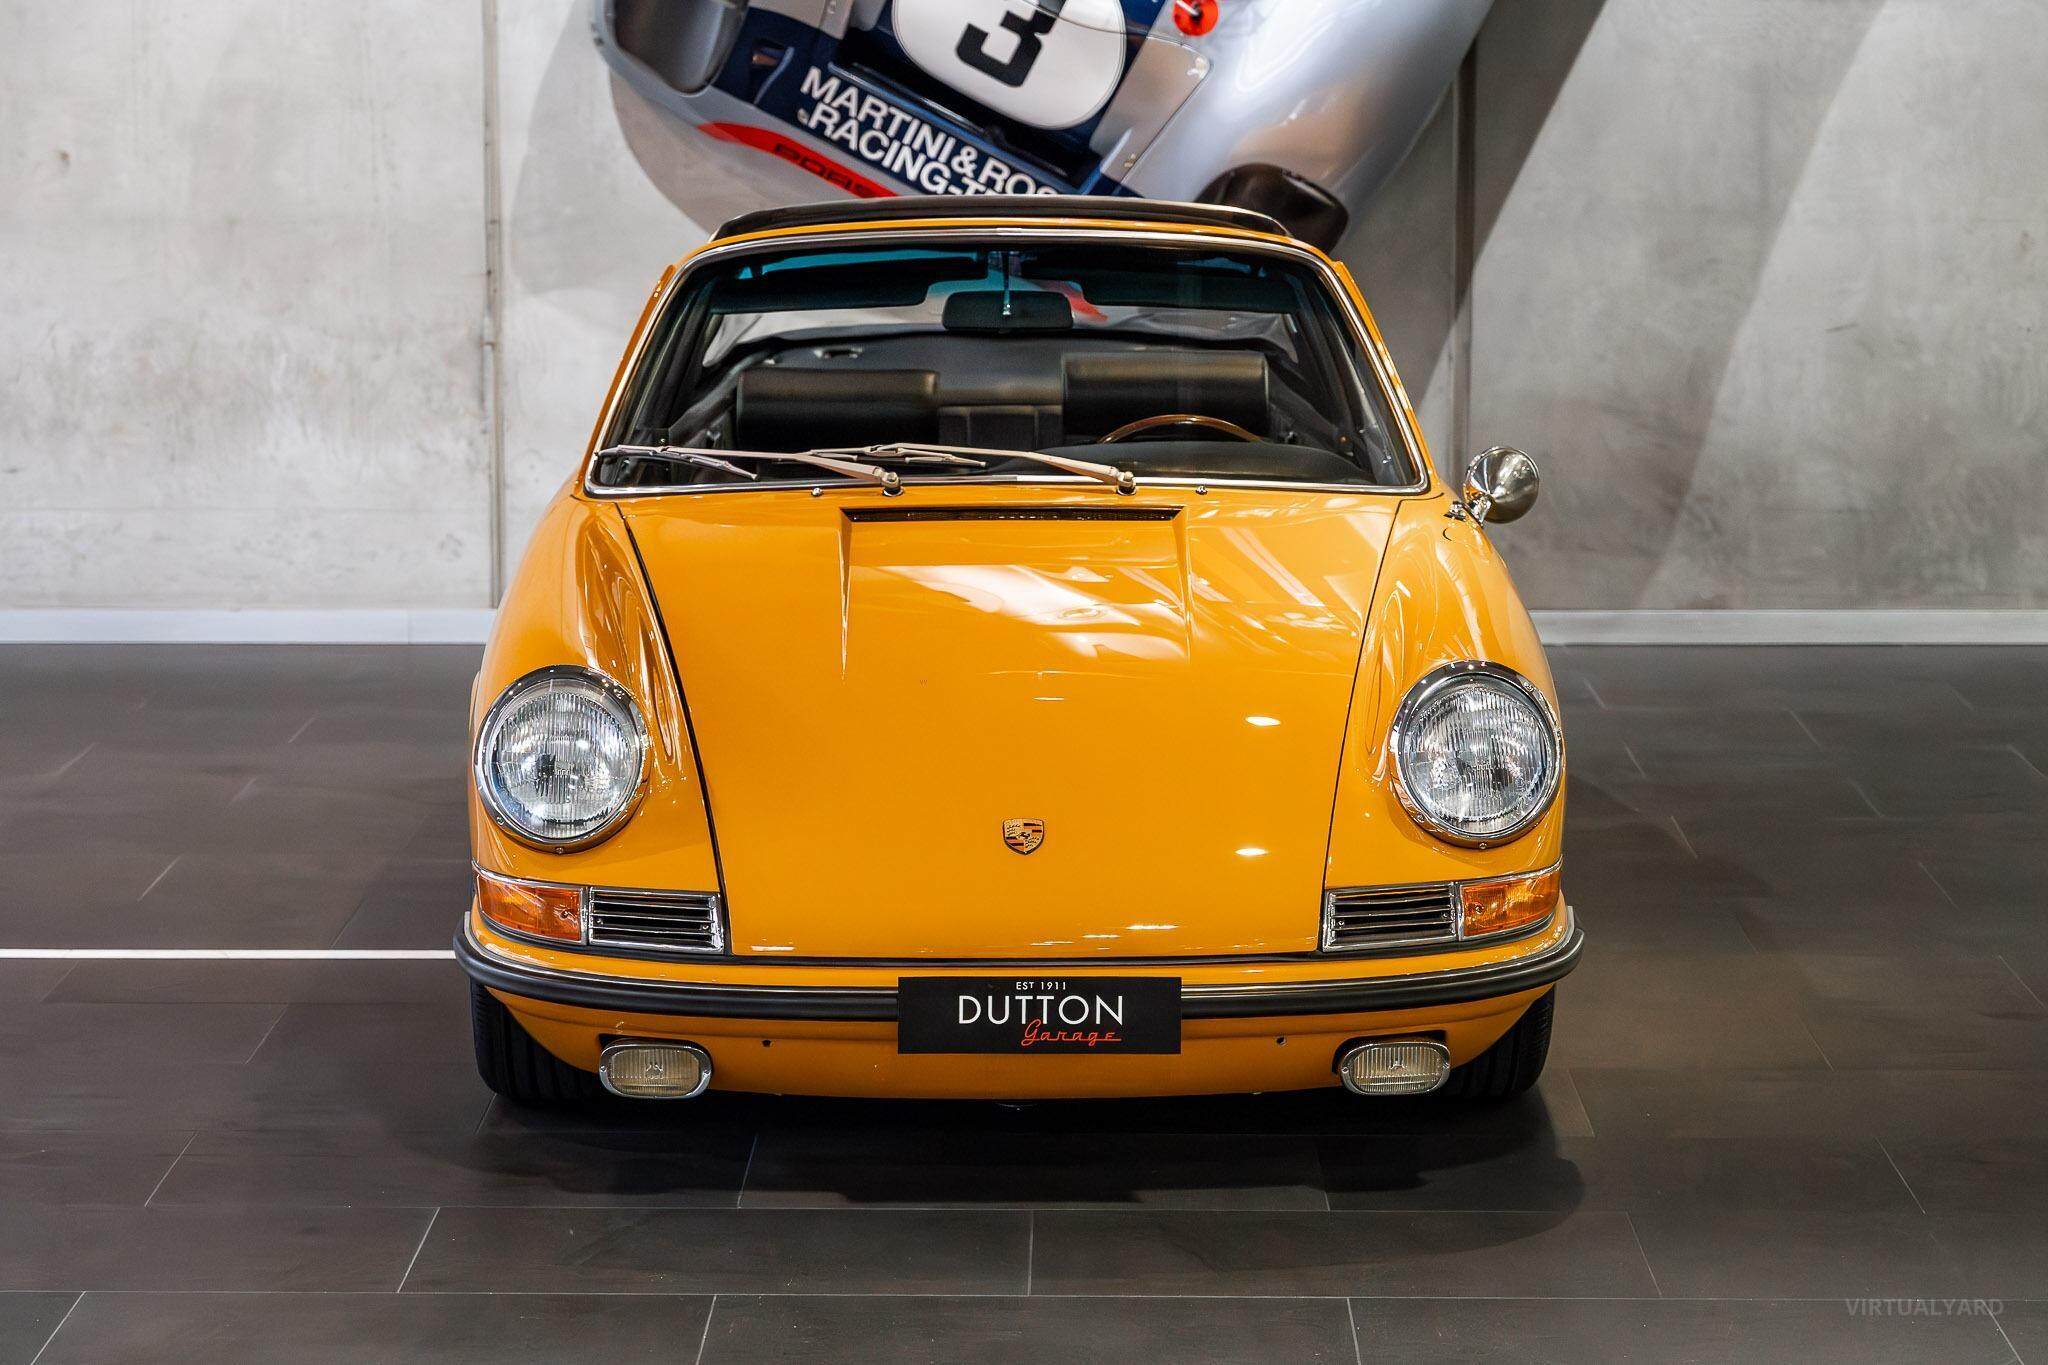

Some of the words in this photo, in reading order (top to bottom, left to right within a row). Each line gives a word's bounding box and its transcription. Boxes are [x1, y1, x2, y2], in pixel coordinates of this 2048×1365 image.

[956, 0, 1067, 88] 3
[800, 66, 956, 163] MARTINI
[808, 101, 1000, 195] RACING-T
[958, 995, 1123, 1025] DUTTON
[1015, 981, 1034, 990] EST
[1040, 981, 1067, 990] 1911
[1020, 1018, 1122, 1046] Garage
